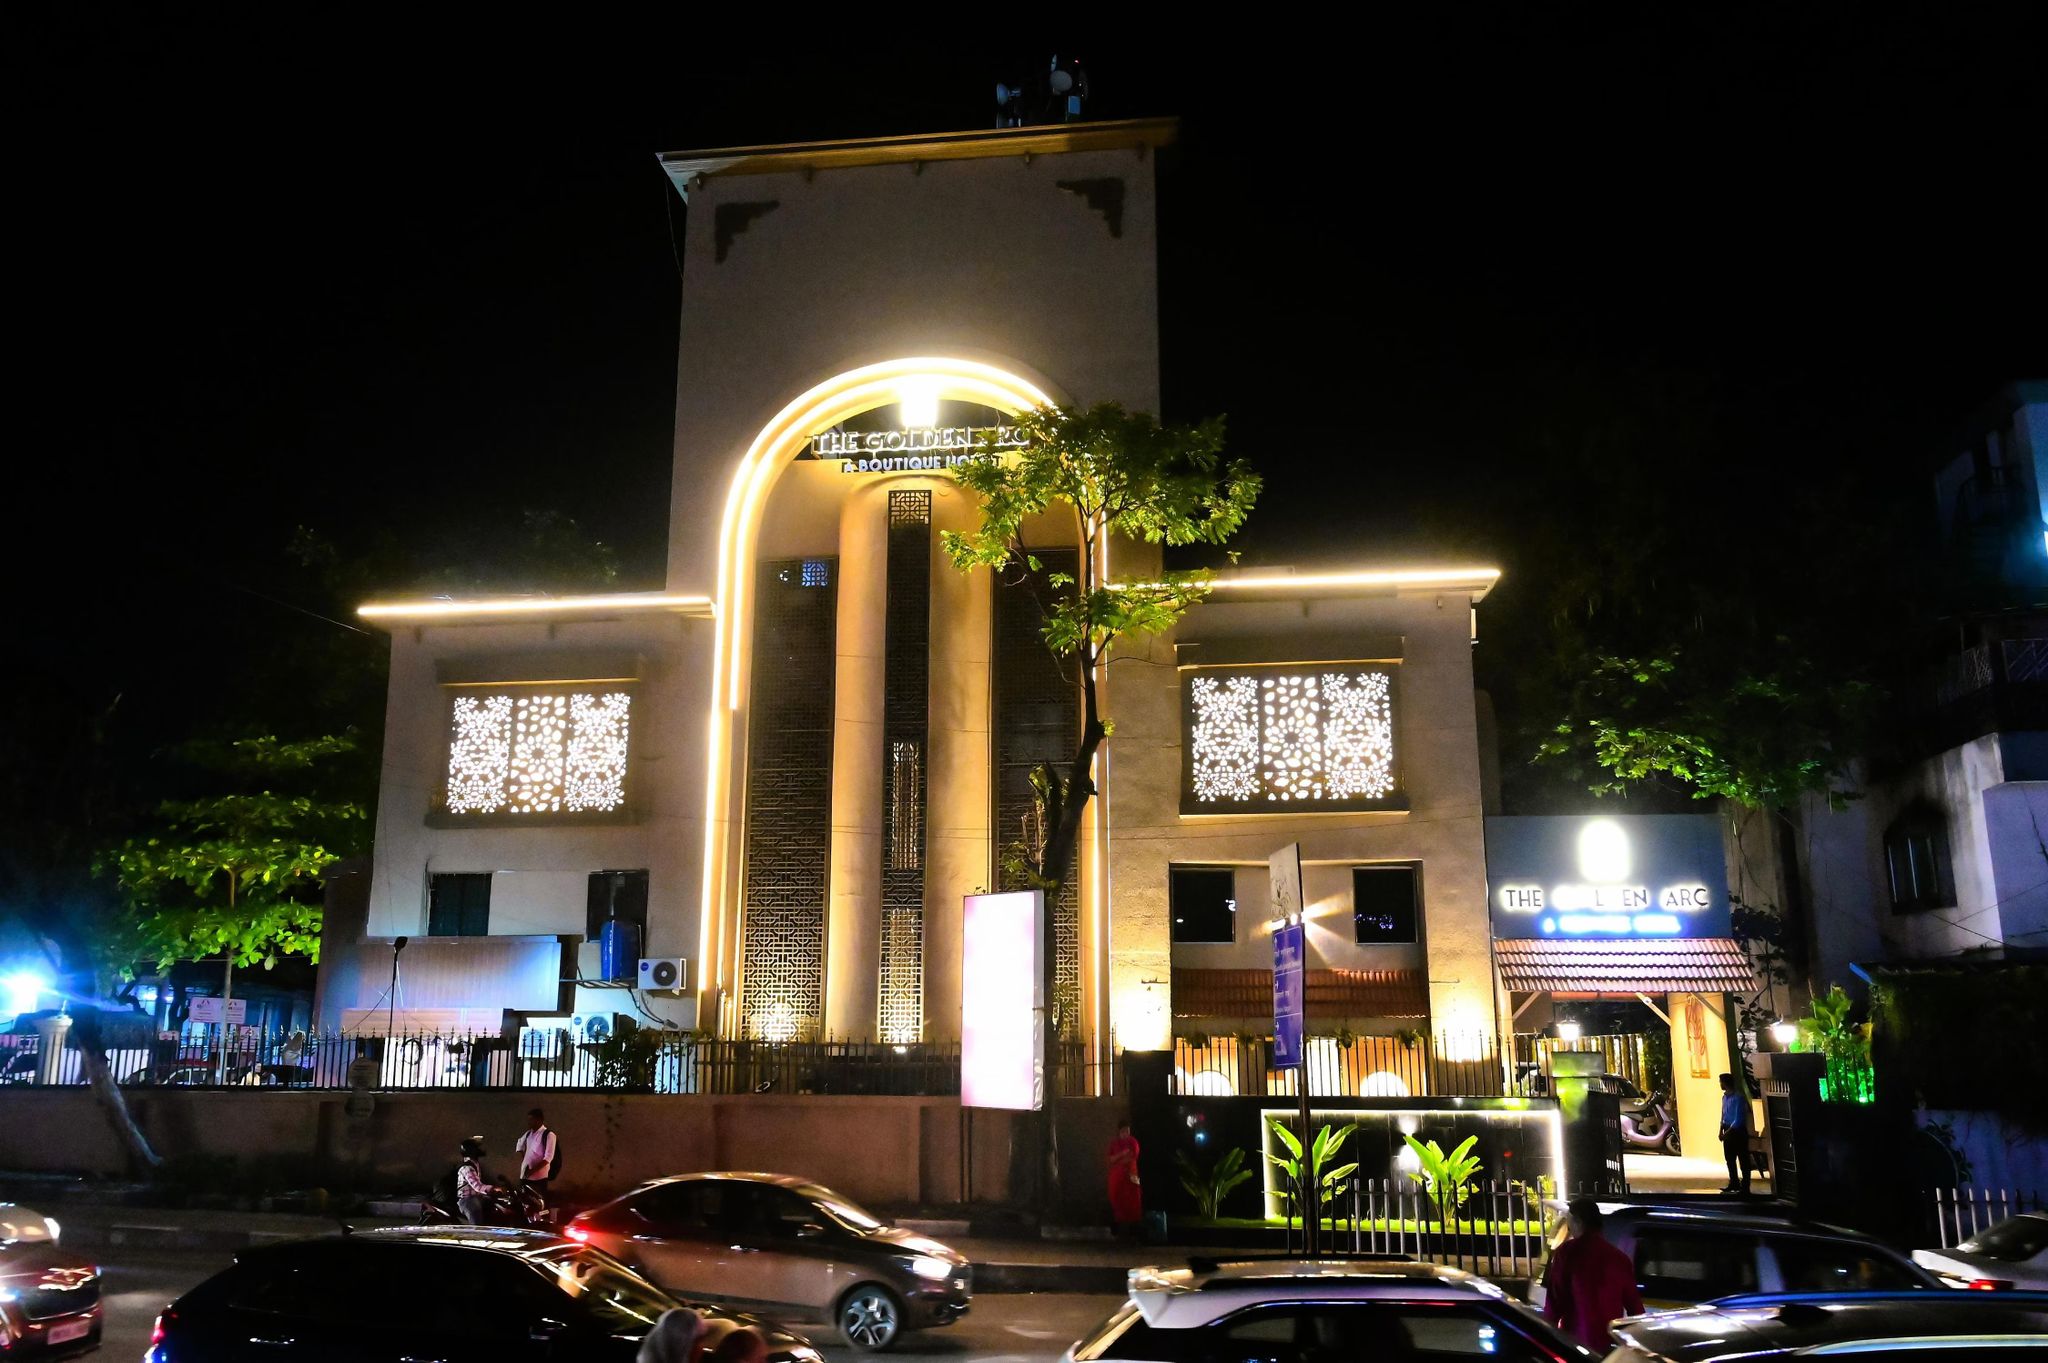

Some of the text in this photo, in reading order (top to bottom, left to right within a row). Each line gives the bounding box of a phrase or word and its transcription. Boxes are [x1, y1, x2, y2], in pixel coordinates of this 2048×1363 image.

[811, 431, 858, 454] THE
[858, 455, 941, 474] BOUTIQUE
[1506, 888, 1709, 907] THE LEN ARC
